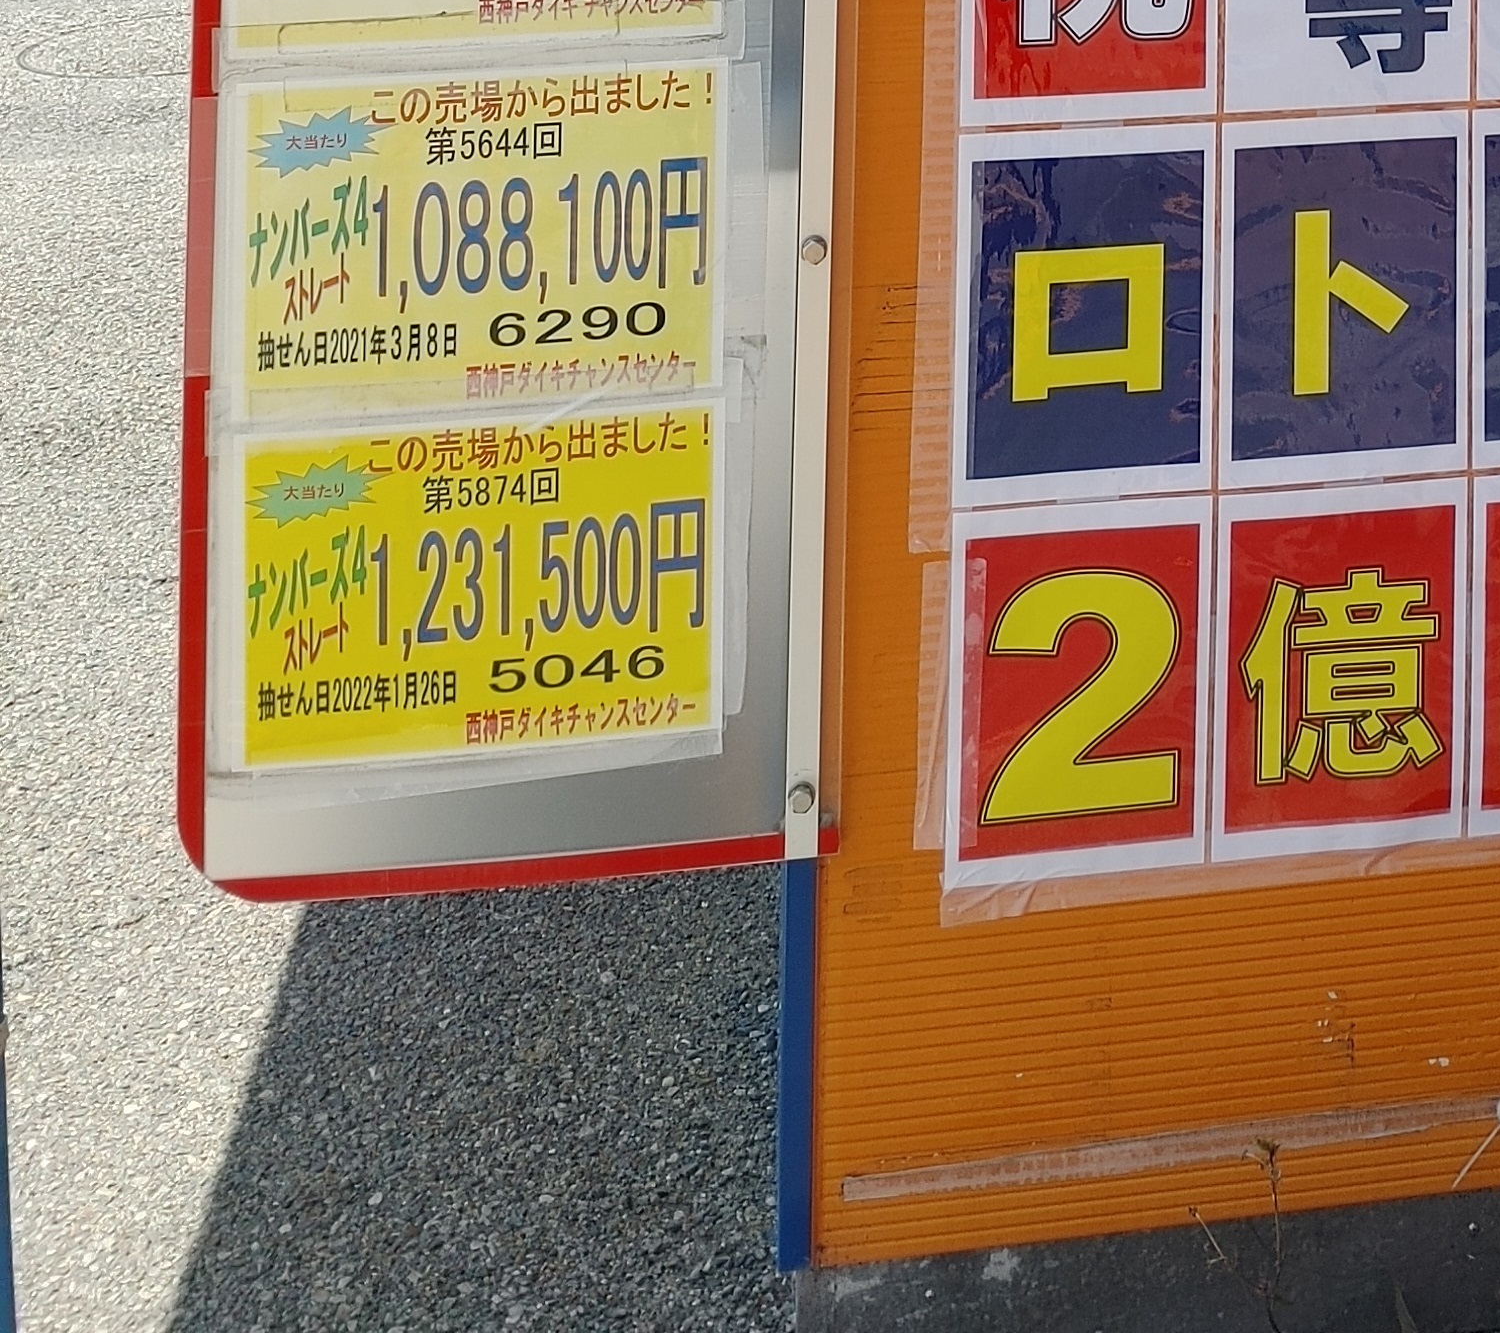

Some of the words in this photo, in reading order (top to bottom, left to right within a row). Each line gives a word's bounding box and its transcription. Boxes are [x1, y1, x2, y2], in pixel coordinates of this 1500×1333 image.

[370, 70, 714, 126] この売場から出ました！
[285, 132, 348, 150] 大当たり
[426, 121, 563, 165] 第5644回
[249, 175, 368, 289] ナンバーズ4
[373, 156, 708, 313] 1,088,100円
[283, 252, 350, 325] ストレート
[257, 321, 458, 371] 抽せん日2021年3月8日
[488, 301, 667, 348] 6290
[465, 351, 696, 400] 西神戸ダイキチャンスセンター
[367, 412, 711, 474] この売場から出ました！
[283, 482, 346, 501] 大当たり
[423, 468, 560, 514] 第5874回
[248, 524, 367, 639] ナンバーズ4
[370, 497, 705, 662] 1,231,500円
[283, 604, 350, 675] ストレート
[257, 670, 457, 720] 抽せん日2022年1月26日
[488, 645, 666, 693] 5046
[465, 694, 696, 745] 西神戸ダイキチャンスセンター
